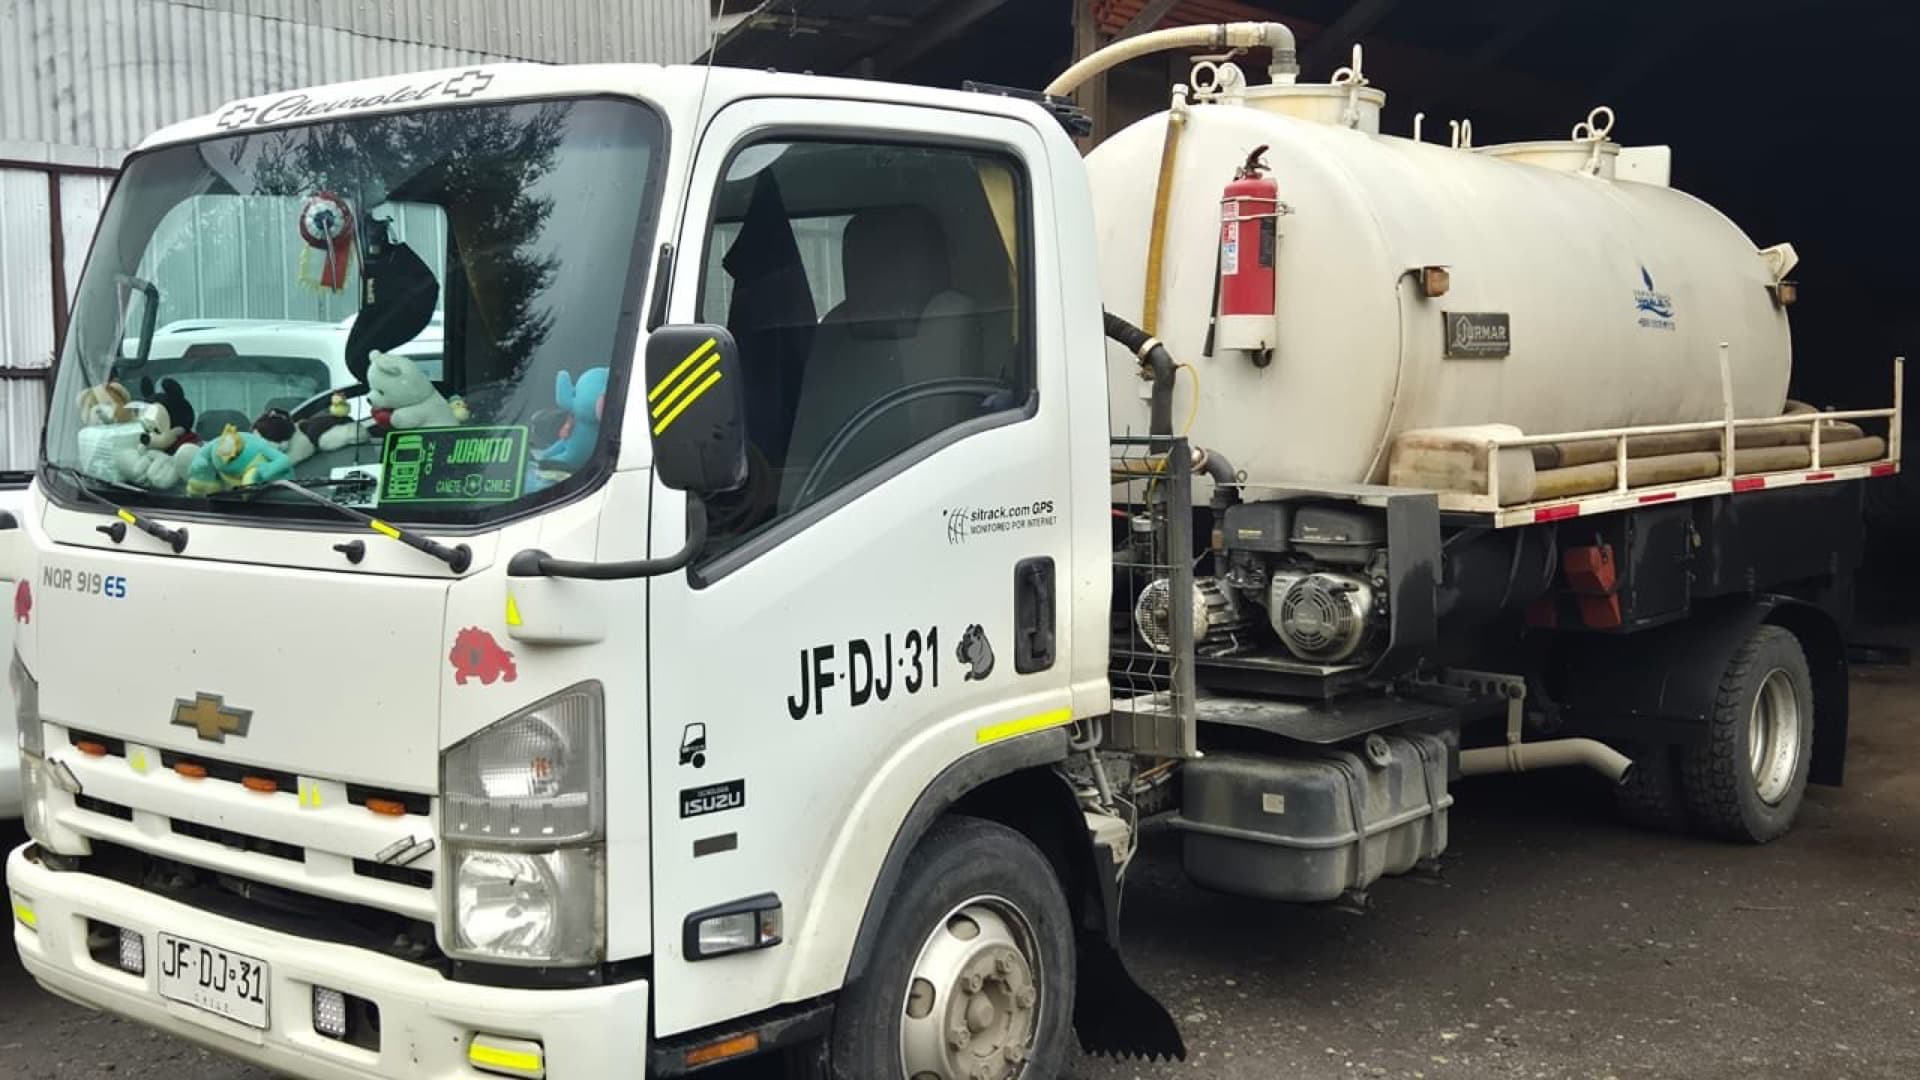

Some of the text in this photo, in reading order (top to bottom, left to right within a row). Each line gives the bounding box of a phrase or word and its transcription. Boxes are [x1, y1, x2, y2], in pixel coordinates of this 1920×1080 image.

[255, 81, 443, 125] Chevrolet
[447, 437, 513, 464] JUANITO
[484, 479, 512, 493] CHILE
[970, 500, 1054, 522] sitrack.com GPS
[77, 570, 102, 595] 919
[104, 575, 126, 598] E5
[684, 791, 741, 816] ISUZU
